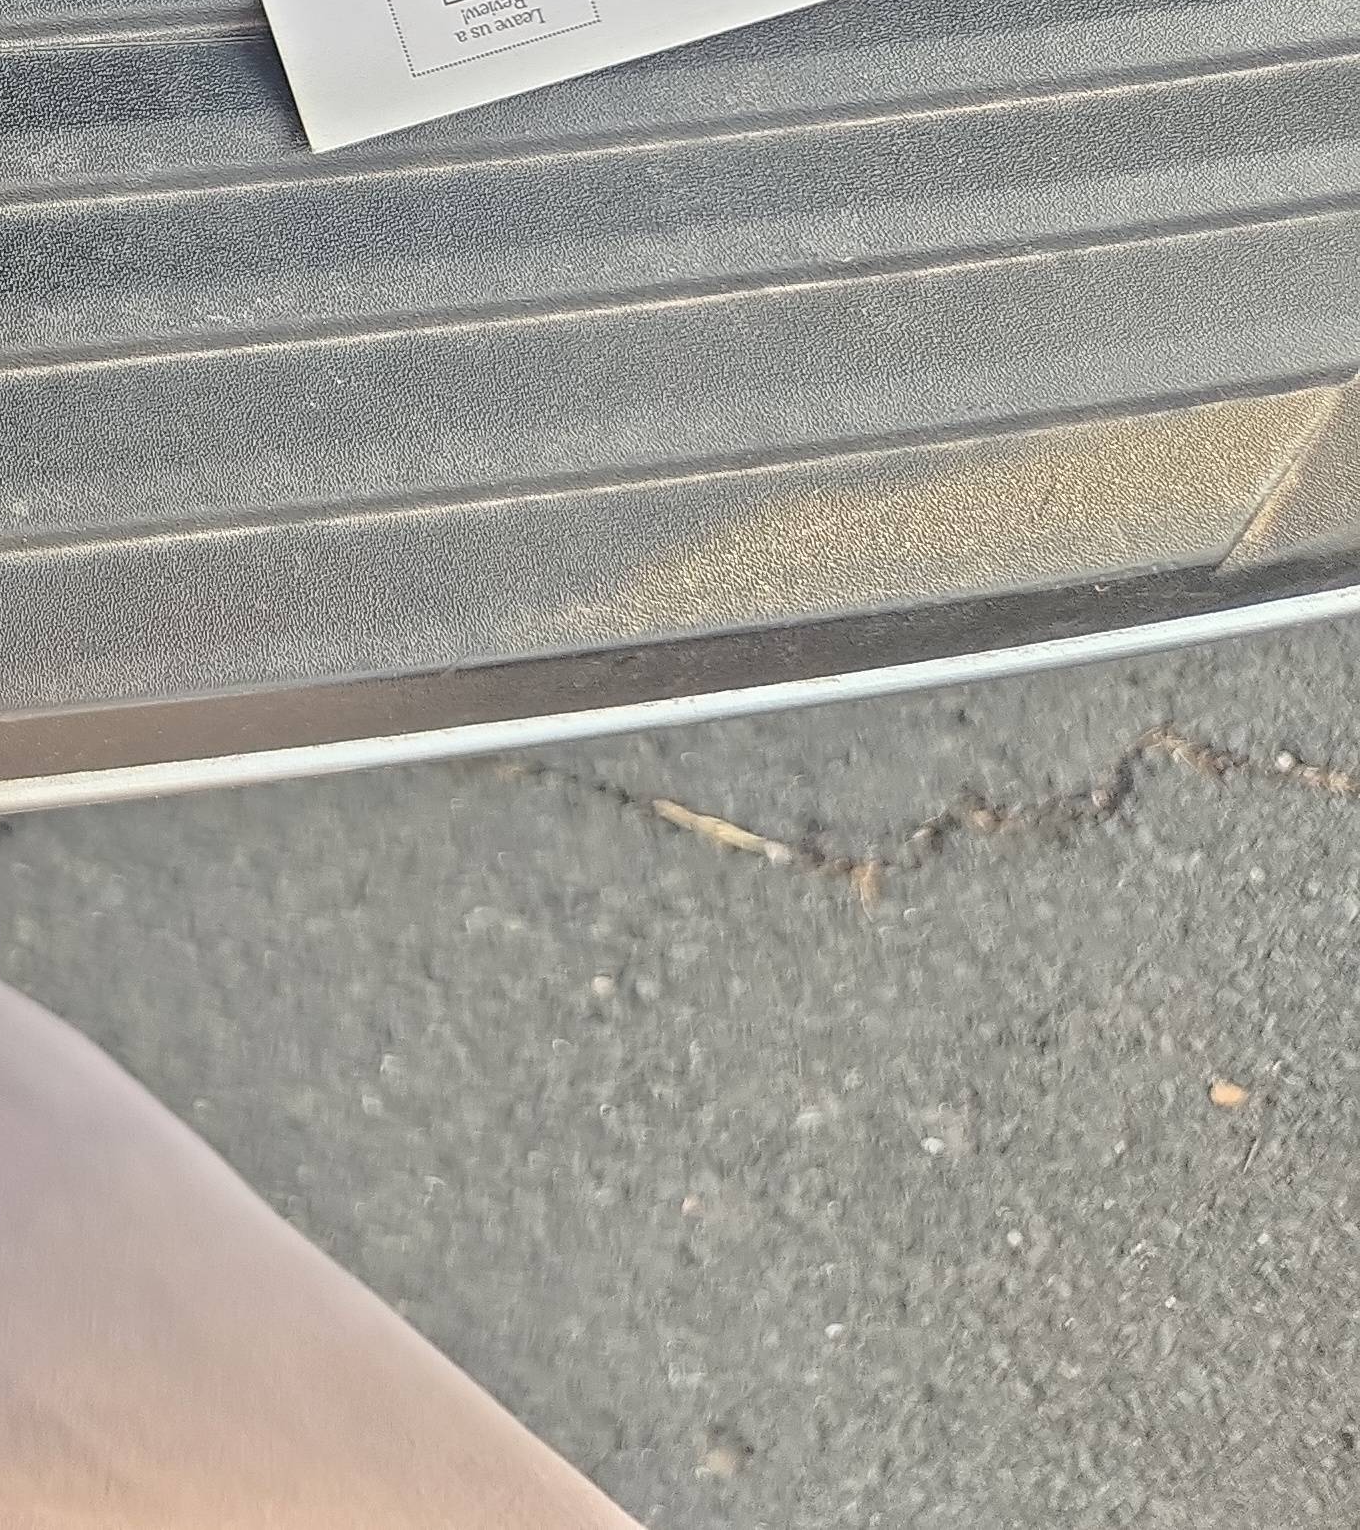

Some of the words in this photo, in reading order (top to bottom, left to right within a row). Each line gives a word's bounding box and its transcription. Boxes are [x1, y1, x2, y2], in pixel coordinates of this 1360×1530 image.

[495, 9, 543, 34] Leave
[454, 31, 466, 42] a
[471, 24, 490, 37] us
